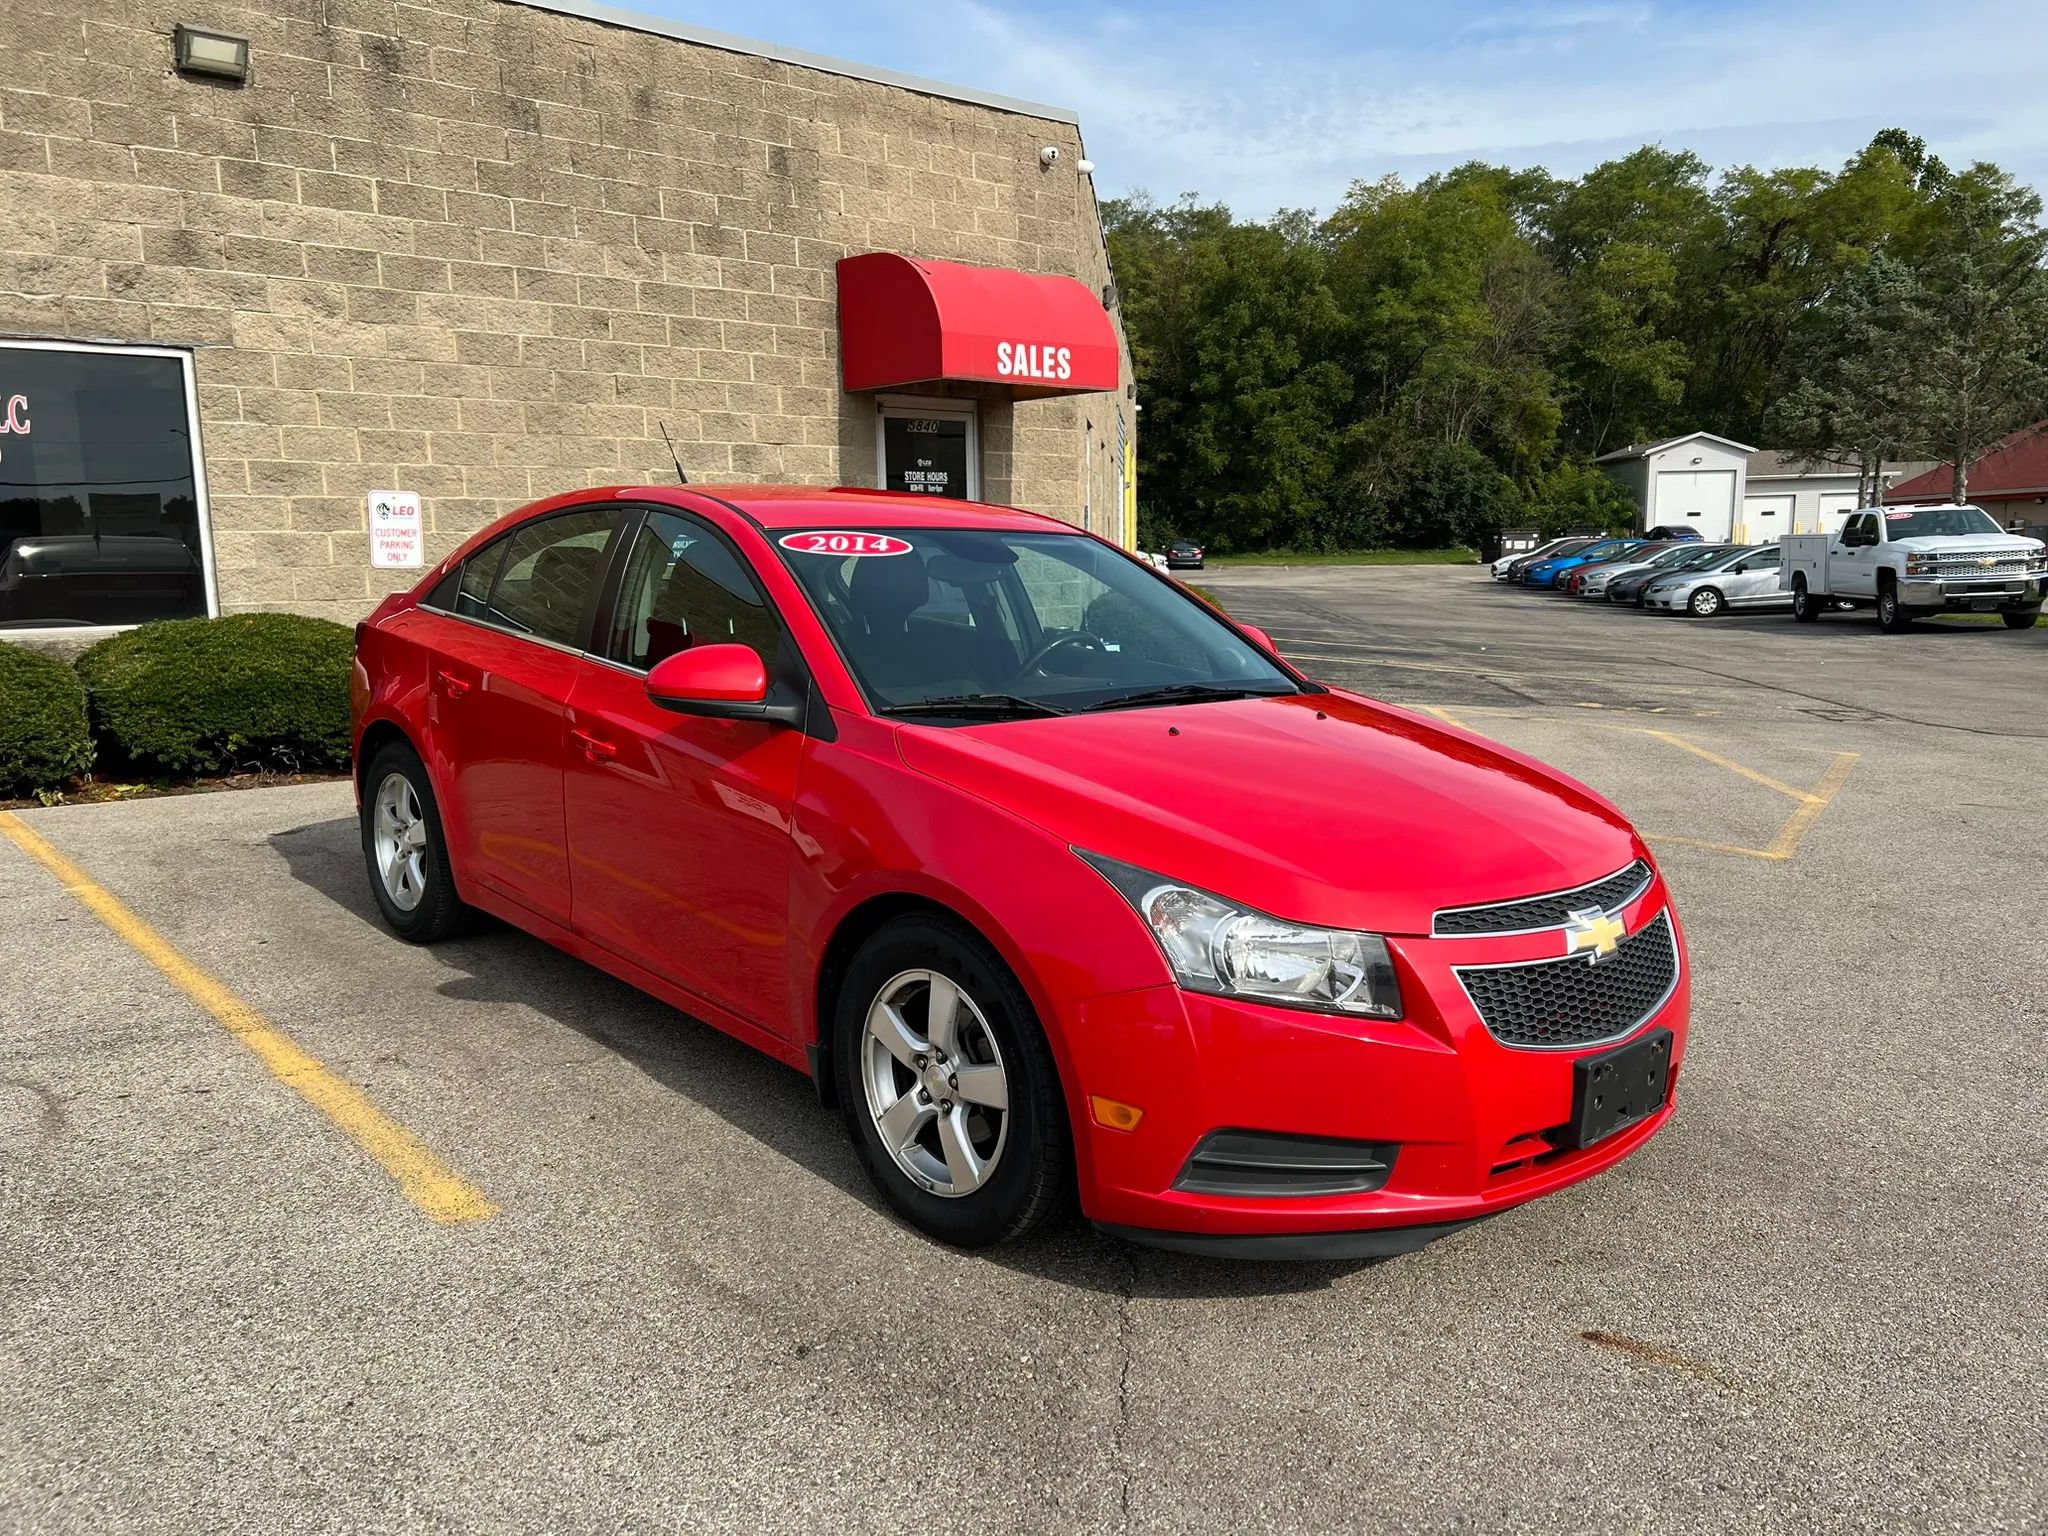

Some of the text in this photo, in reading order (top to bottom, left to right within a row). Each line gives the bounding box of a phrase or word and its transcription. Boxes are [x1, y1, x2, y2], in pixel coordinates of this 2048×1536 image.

[997, 341, 1071, 380] SALES
[908, 420, 938, 432] 5840
[904, 471, 948, 481] STORE HOURS
[392, 506, 414, 515] LEO
[375, 528, 417, 537] CUSTOMER
[380, 540, 414, 549] PARKING
[808, 536, 889, 551] 2014
[387, 552, 407, 561] ONLY
